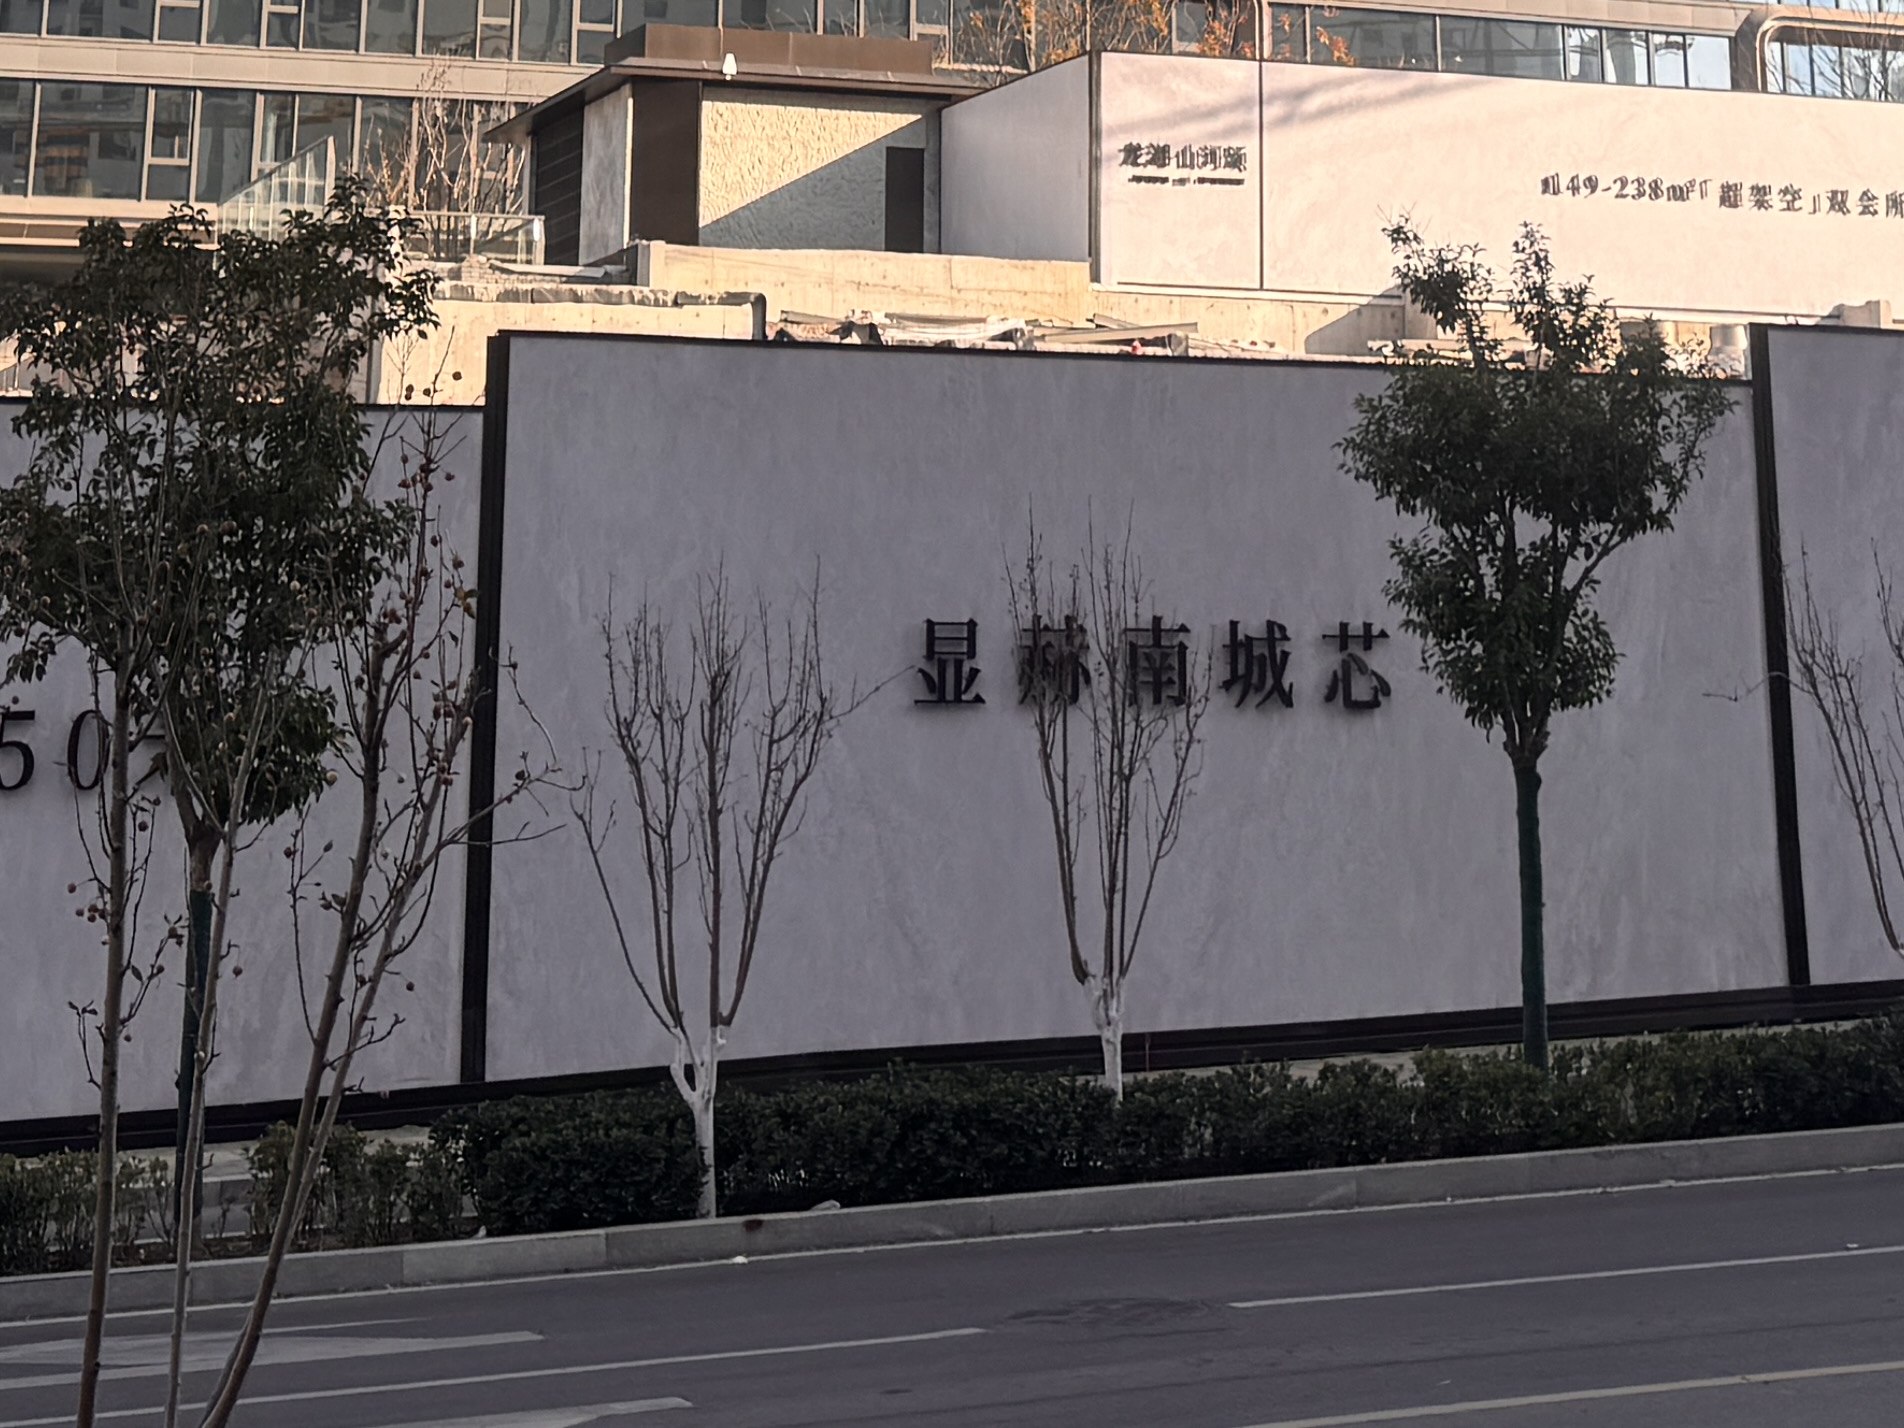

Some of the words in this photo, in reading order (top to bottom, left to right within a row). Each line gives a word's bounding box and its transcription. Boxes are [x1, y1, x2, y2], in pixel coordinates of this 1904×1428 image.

[914, 615, 1391, 710] 显赫南城芯
